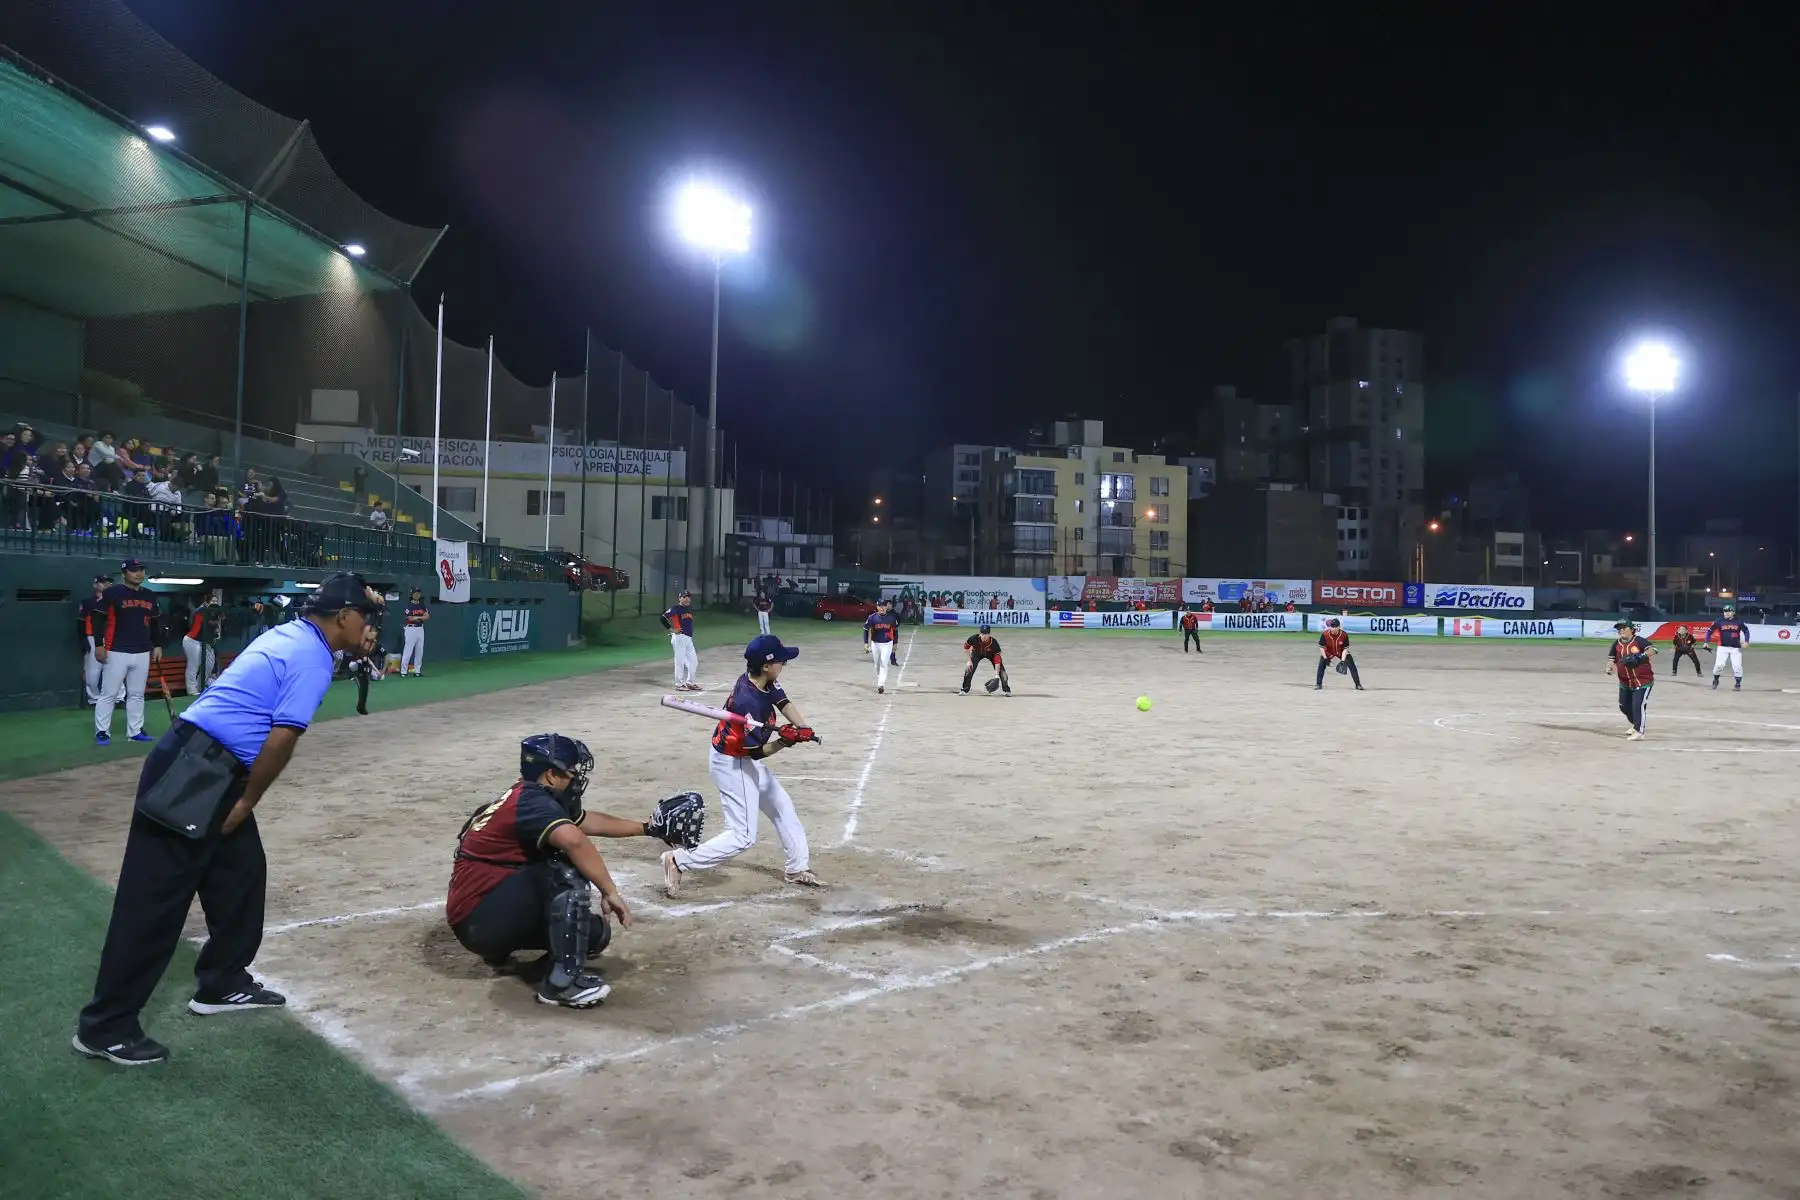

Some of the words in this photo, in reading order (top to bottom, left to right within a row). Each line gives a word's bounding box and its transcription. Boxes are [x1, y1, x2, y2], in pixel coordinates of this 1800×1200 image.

[367, 436, 431, 449] MEDCINA
[1321, 586, 1396, 600] BOSTON
[1457, 592, 1526, 608] Pacífico
[973, 610, 1030, 625] TAILANDIA
[1102, 613, 1151, 627] MALASIA
[1225, 614, 1287, 629] INDONESIA
[1370, 618, 1410, 633] COREA
